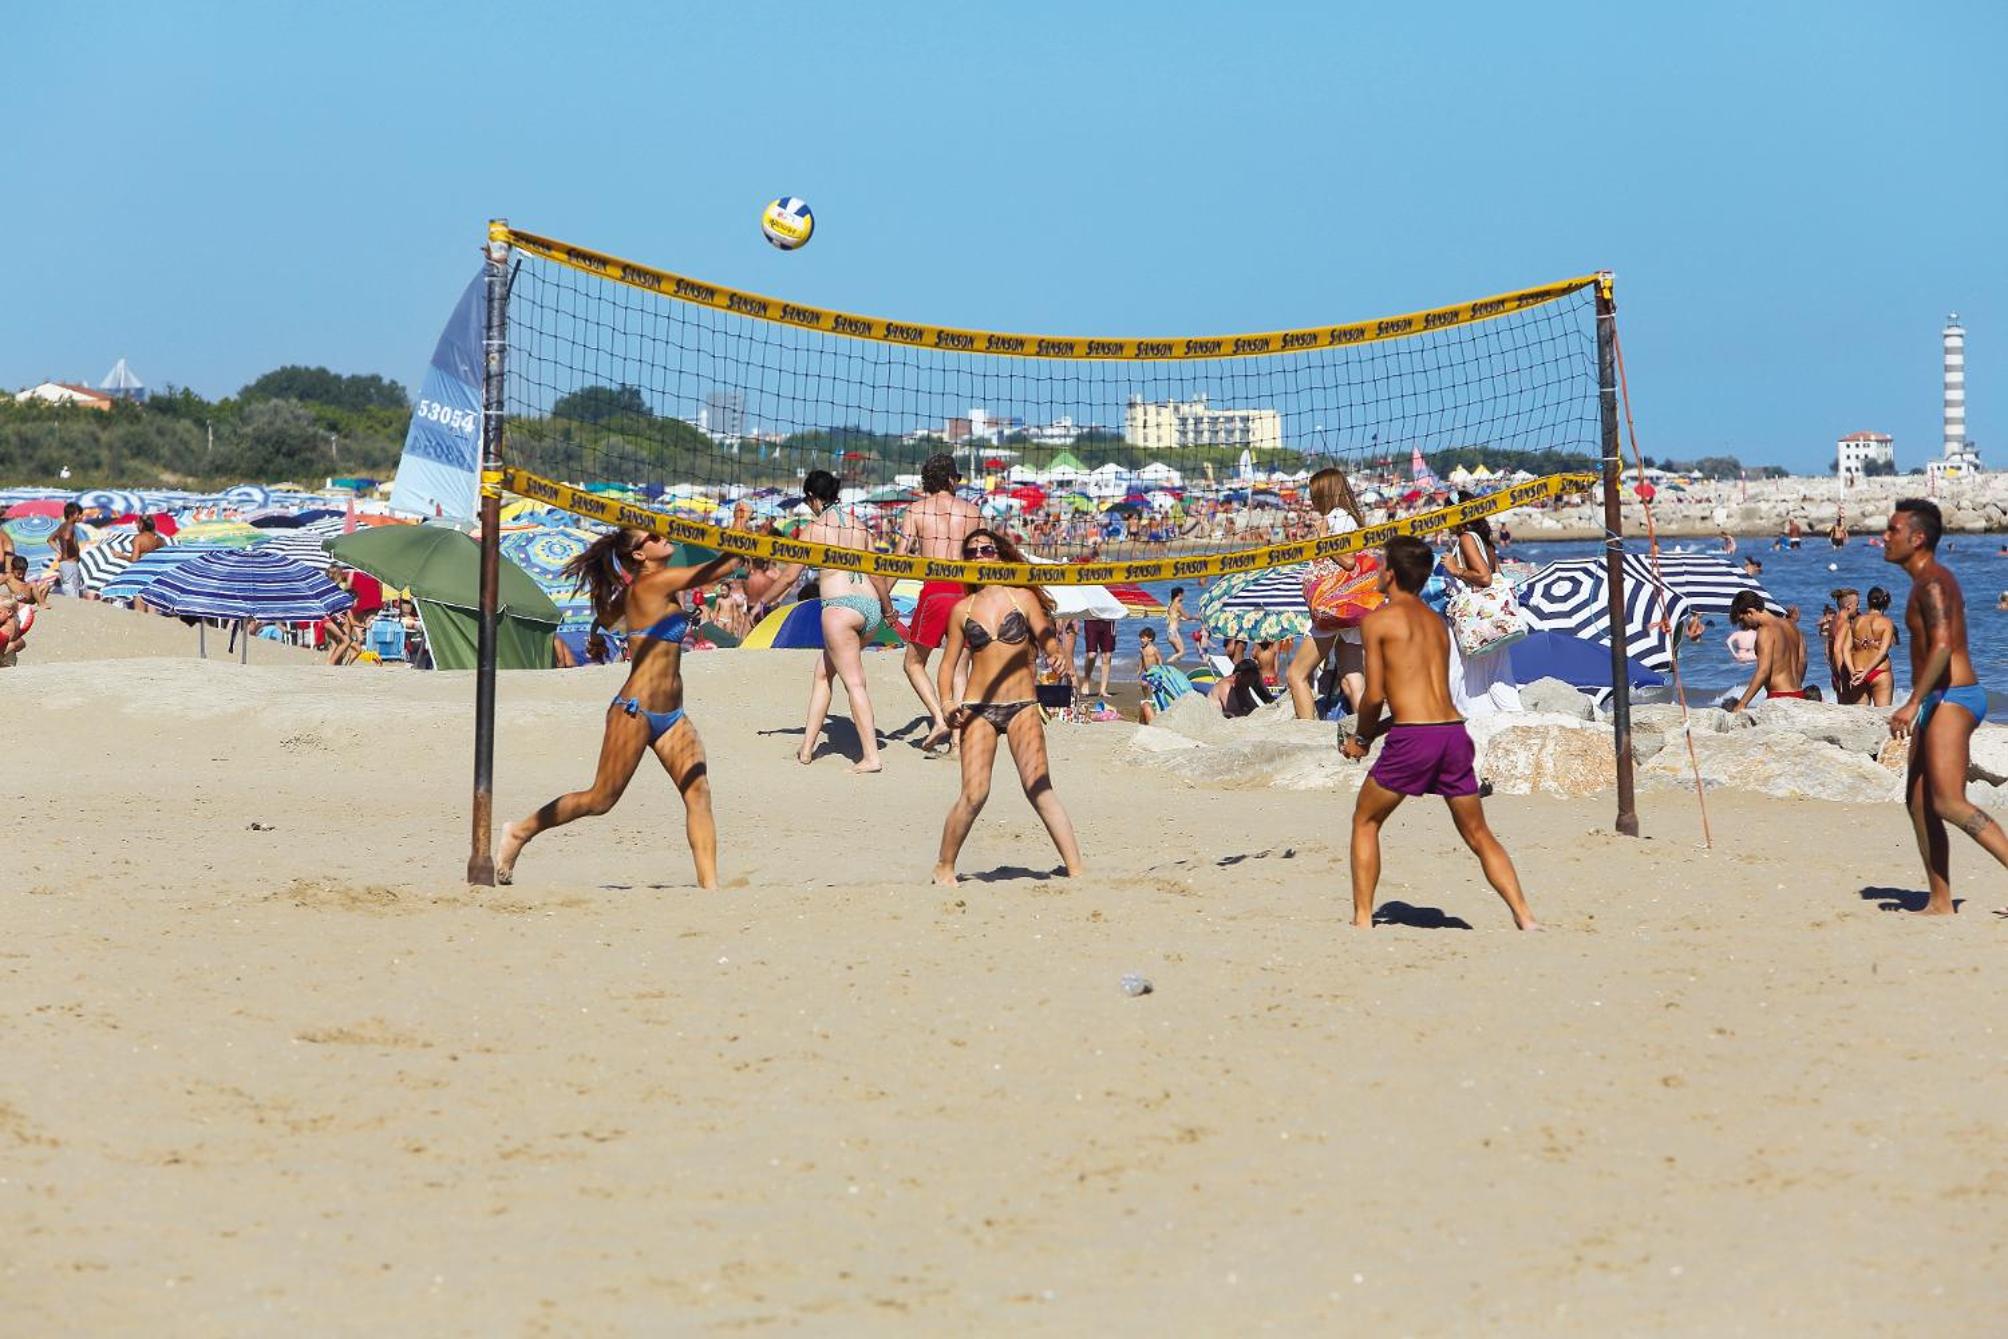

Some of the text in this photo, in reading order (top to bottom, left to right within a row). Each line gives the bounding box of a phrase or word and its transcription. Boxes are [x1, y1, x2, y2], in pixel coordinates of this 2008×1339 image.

[620, 264, 662, 288] SANSON
[674, 278, 716, 302] SANSON
[727, 292, 768, 316] SANSON
[780, 304, 822, 325] SANSON
[832, 314, 873, 335] SANSON
[884, 323, 924, 342] SANSON
[935, 330, 975, 348] SANSON
[986, 335, 1026, 351] SANSON
[1037, 339, 1076, 355] SANSON
[1086, 341, 1125, 355] SANSON
[1136, 341, 1174, 356] SANSON
[1185, 340, 1223, 355] SANSON
[1233, 338, 1271, 353] SANSON
[1281, 333, 1318, 350] SANSON
[1329, 327, 1366, 345] SANSON
[1377, 318, 1413, 337] SANSON
[1424, 310, 1460, 329] SANSON
[1471, 299, 1507, 318] SANSON
[418, 399, 476, 433] 53054
[527, 477, 559, 499] SANSON
[570, 492, 607, 515] SANSON
[616, 506, 658, 528] SANSON
[667, 520, 708, 541] SANSON
[718, 531, 759, 552] SANSON
[770, 541, 811, 560] SANSON
[822, 549, 862, 567] SANSON
[874, 556, 914, 574] SANSON
[925, 561, 966, 578] SANSON
[978, 565, 1018, 581] SANSON
[1029, 567, 1066, 582] SANSON
[1078, 567, 1115, 582] SANSON
[1125, 564, 1162, 580] SANSON
[1173, 560, 1209, 575] SANSON
[1220, 554, 1256, 570] SANSON
[1267, 547, 1304, 565] SANSON
[1315, 537, 1351, 556] SANSON
[1363, 524, 1399, 546] SANSON
[1410, 514, 1447, 535] SANSON
[1461, 501, 1498, 521] SANSON
[1510, 482, 1547, 505] SANSON
